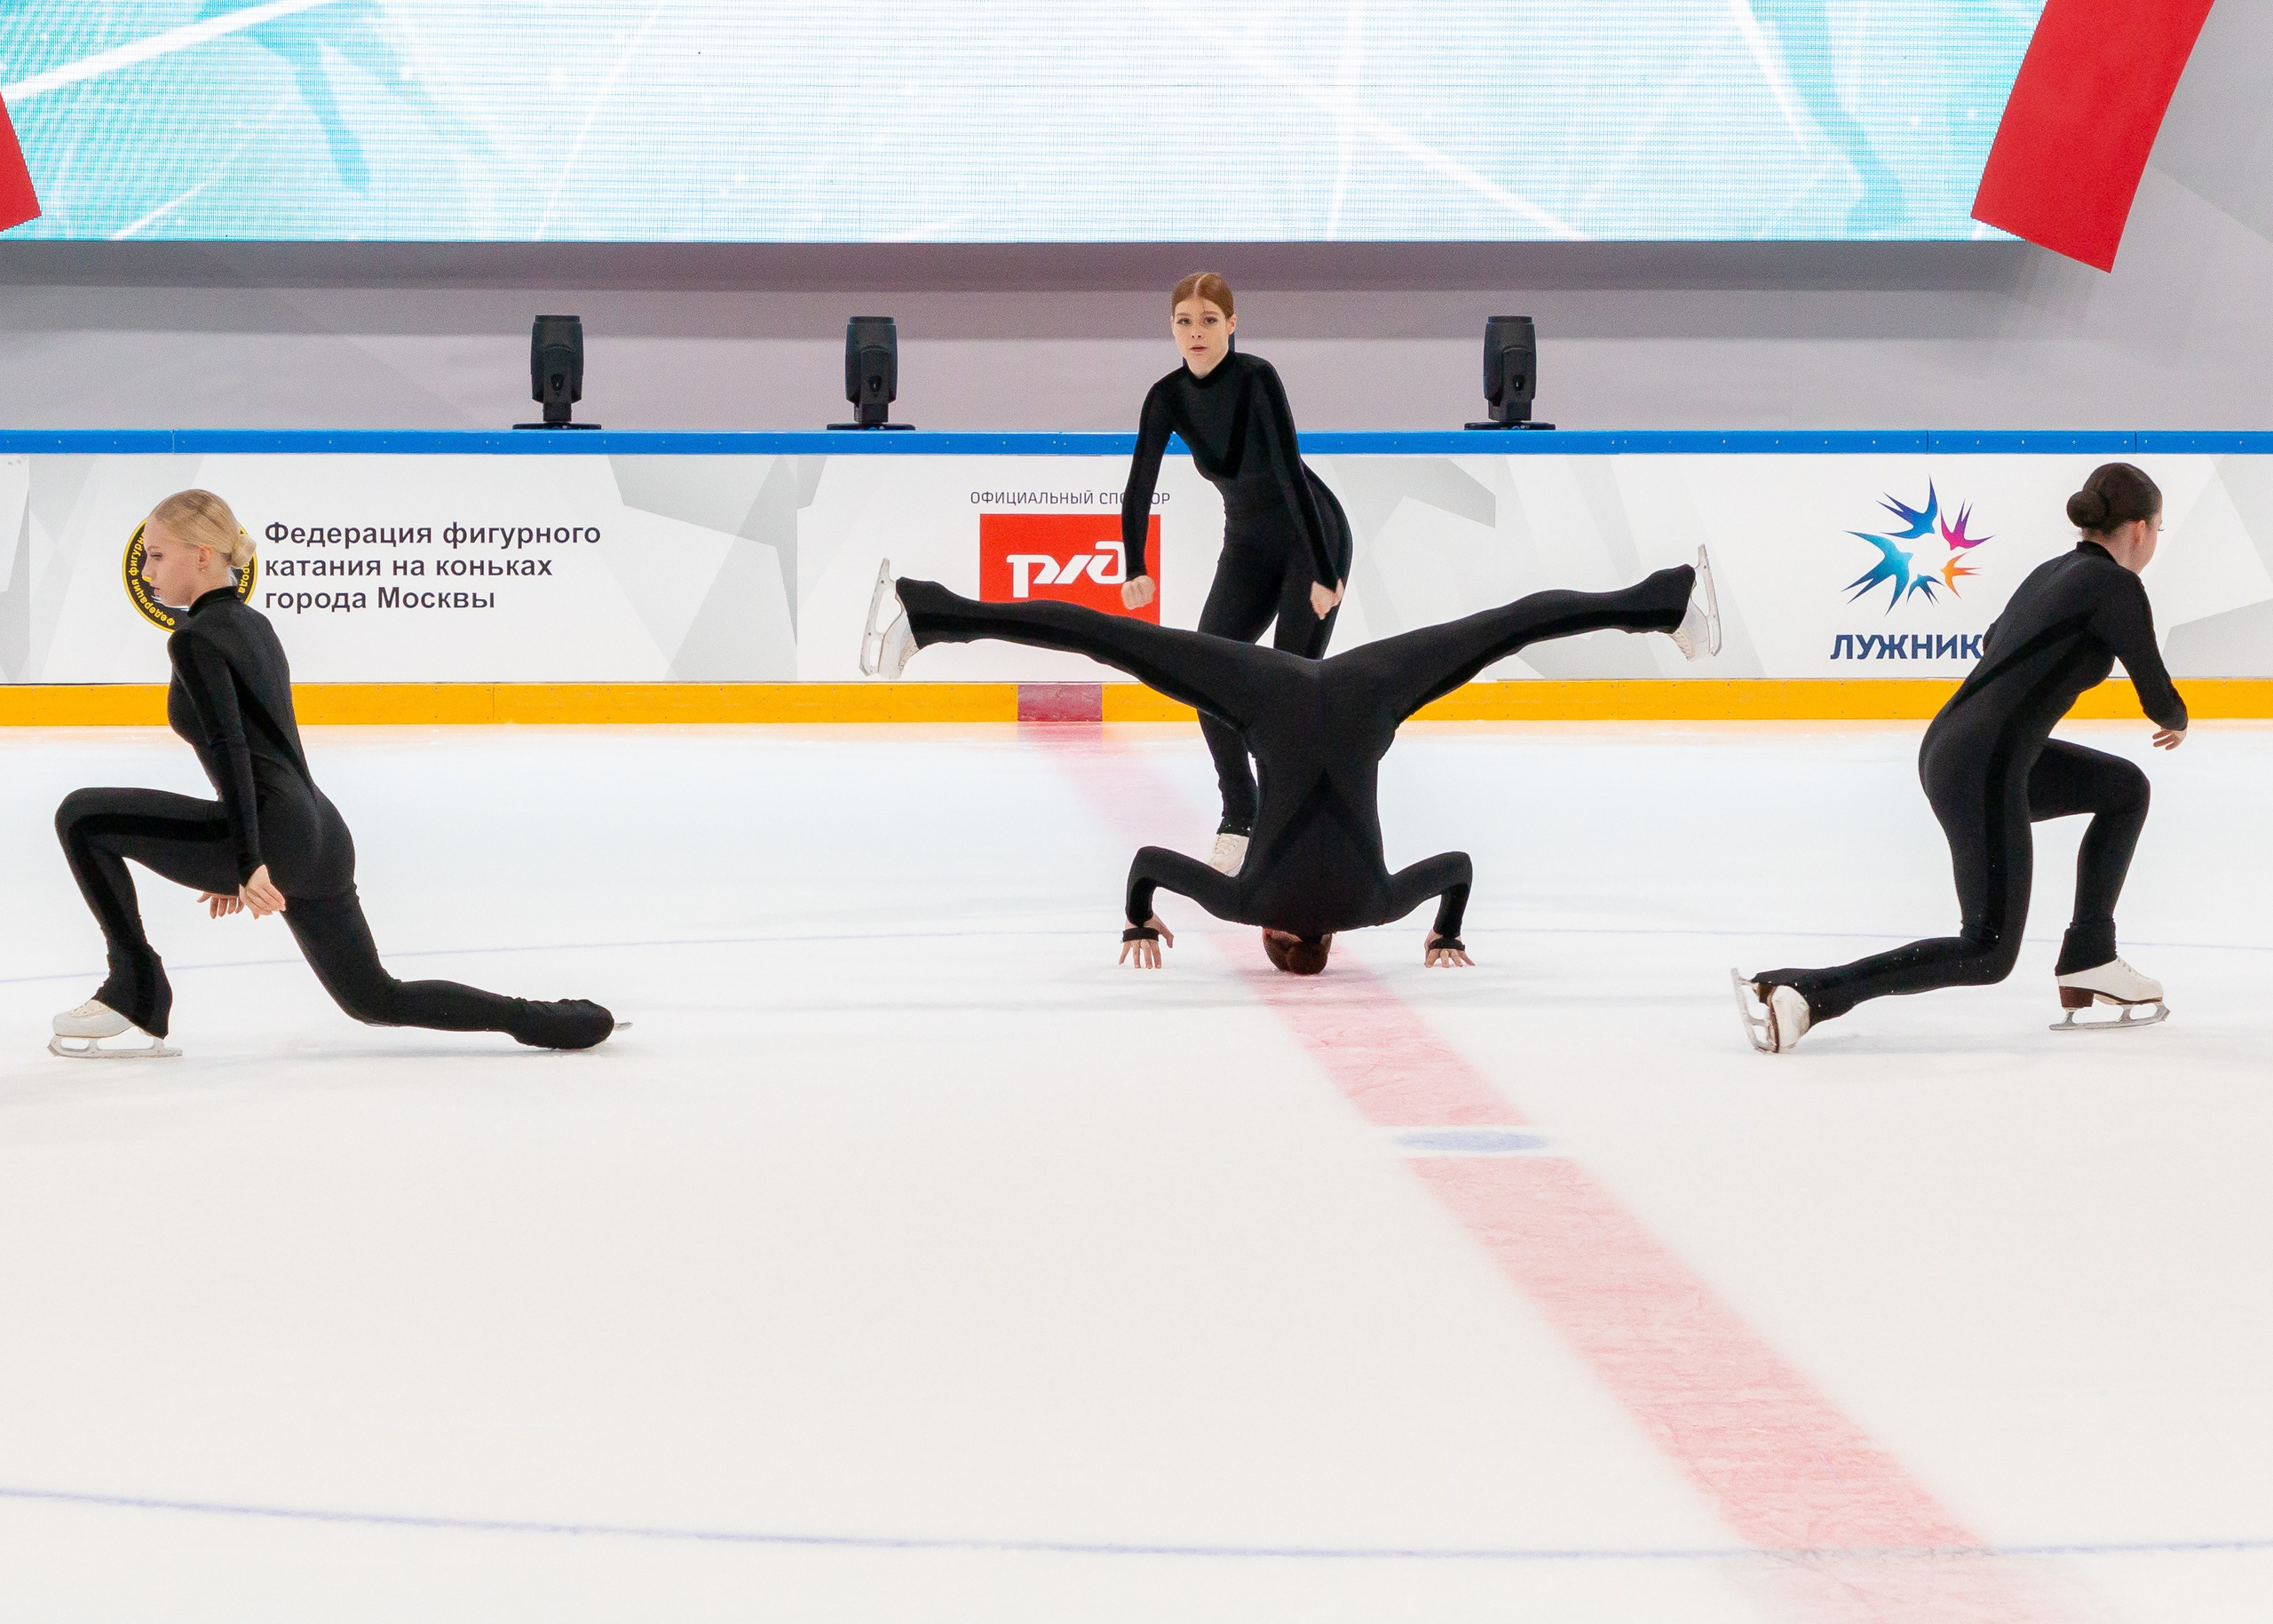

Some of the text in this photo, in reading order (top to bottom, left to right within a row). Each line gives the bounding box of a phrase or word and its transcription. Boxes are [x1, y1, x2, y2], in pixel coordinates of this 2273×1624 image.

[970, 489, 1170, 506] ОФИЦИАЛЬНЫЙ СПОР
[265, 521, 601, 549] Федерация фигурного
[265, 559, 553, 576] катания на коньках
[265, 587, 495, 614] города Москвы
[1830, 634, 1982, 660] ЛУЖНИК
